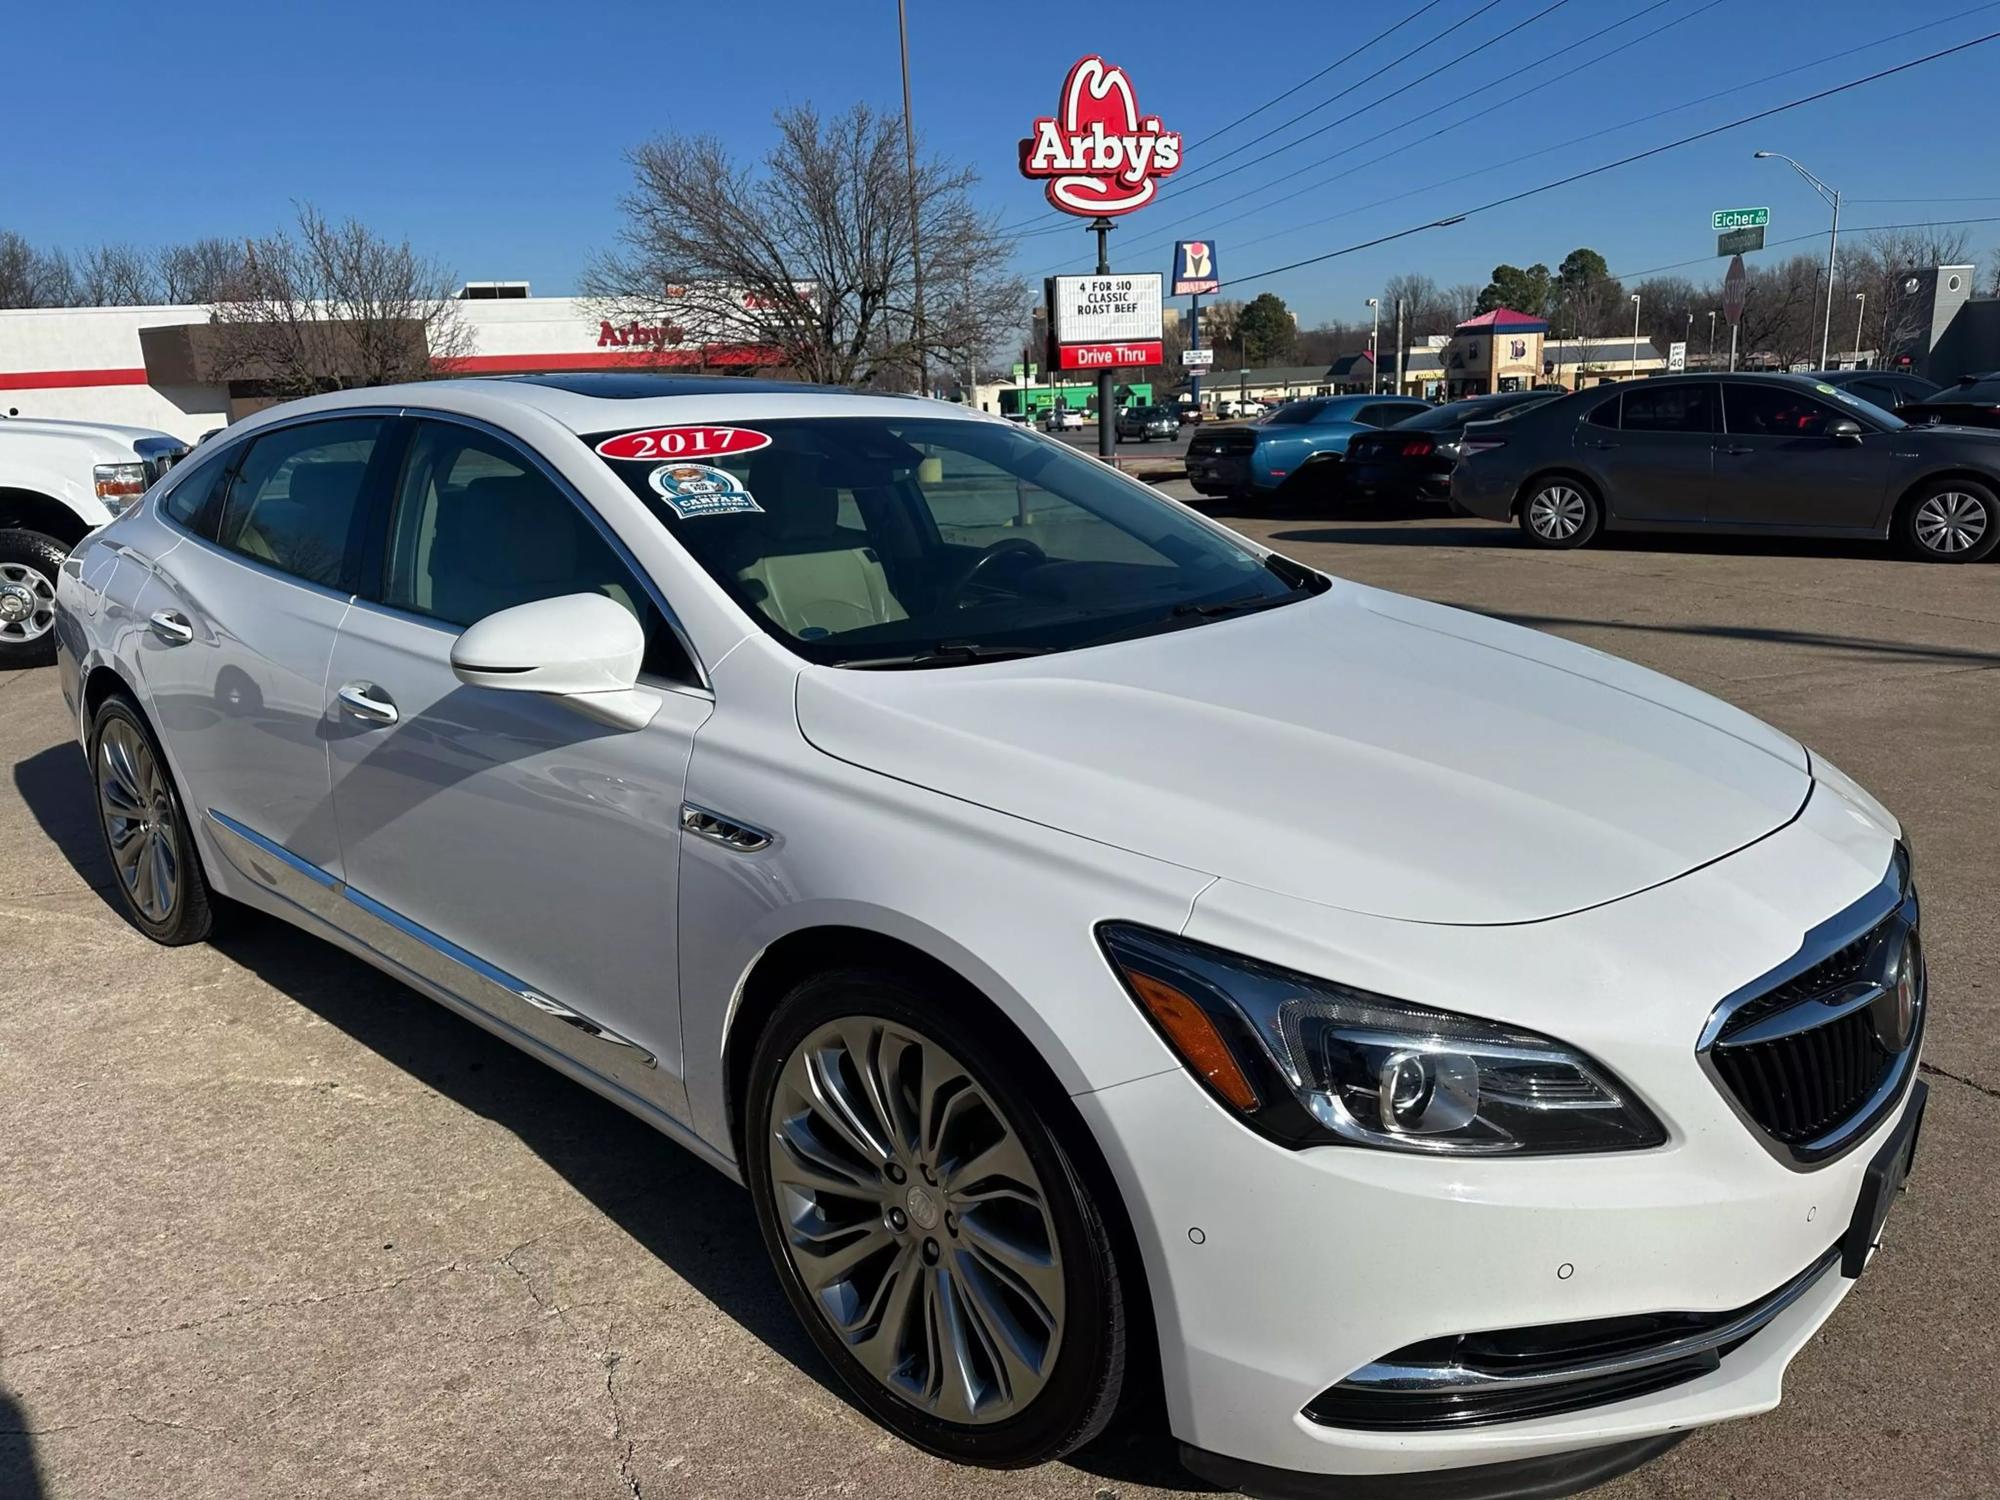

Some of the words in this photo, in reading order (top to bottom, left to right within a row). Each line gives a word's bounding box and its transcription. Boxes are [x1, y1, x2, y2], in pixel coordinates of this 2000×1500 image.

[1031, 119, 1178, 182] Arby's
[1714, 212, 1754, 227] Eicher
[1755, 216, 1767, 224] 800
[1080, 282, 1086, 292] 4
[1092, 281, 1112, 292] FOR
[1116, 280, 1132, 291] $10
[1088, 292, 1129, 303] CLASSIC
[1077, 304, 1110, 315] ROAST
[1114, 303, 1138, 313] BEEF
[597, 318, 683, 353] Arby's
[1078, 348, 1112, 365] Drive
[1115, 347, 1146, 362] Thru
[1670, 358, 1683, 367] 40
[631, 430, 736, 457] 2017
[680, 496, 745, 506] CARFAX
